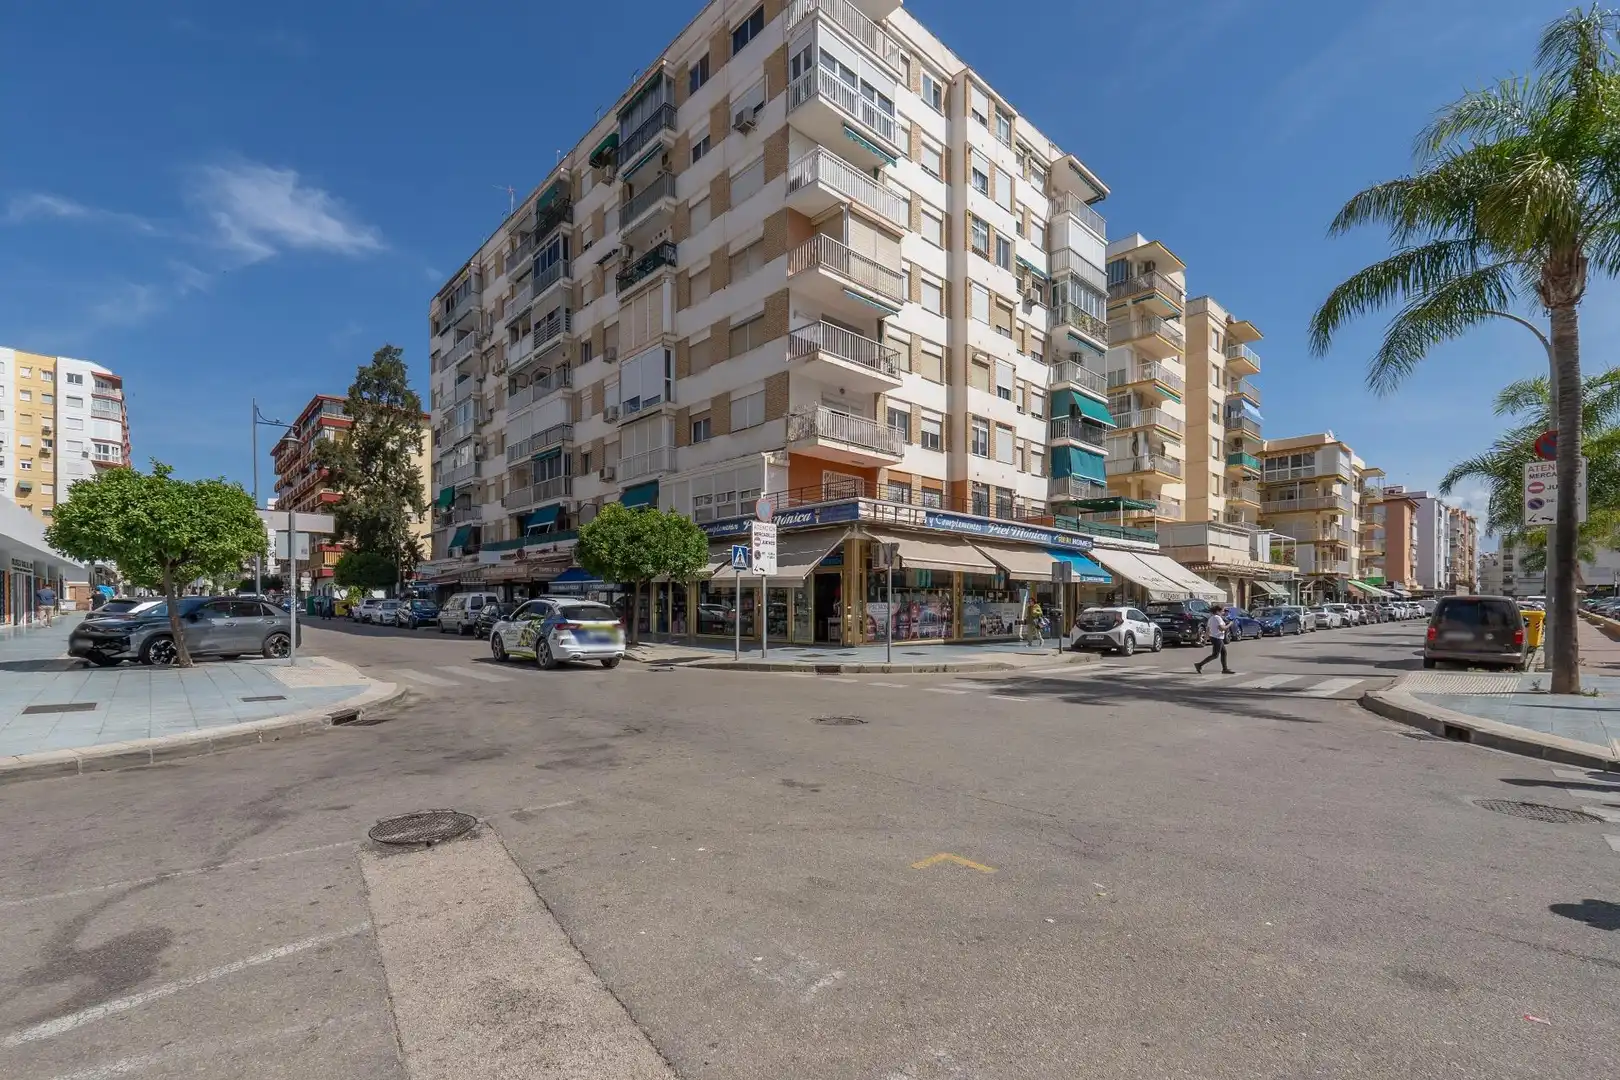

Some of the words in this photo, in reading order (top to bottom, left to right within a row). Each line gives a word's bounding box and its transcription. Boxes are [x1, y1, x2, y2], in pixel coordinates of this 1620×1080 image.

[936, 514, 982, 531] Complementos
[987, 521, 1010, 535] Piel
[1010, 526, 1048, 541] Mónica
